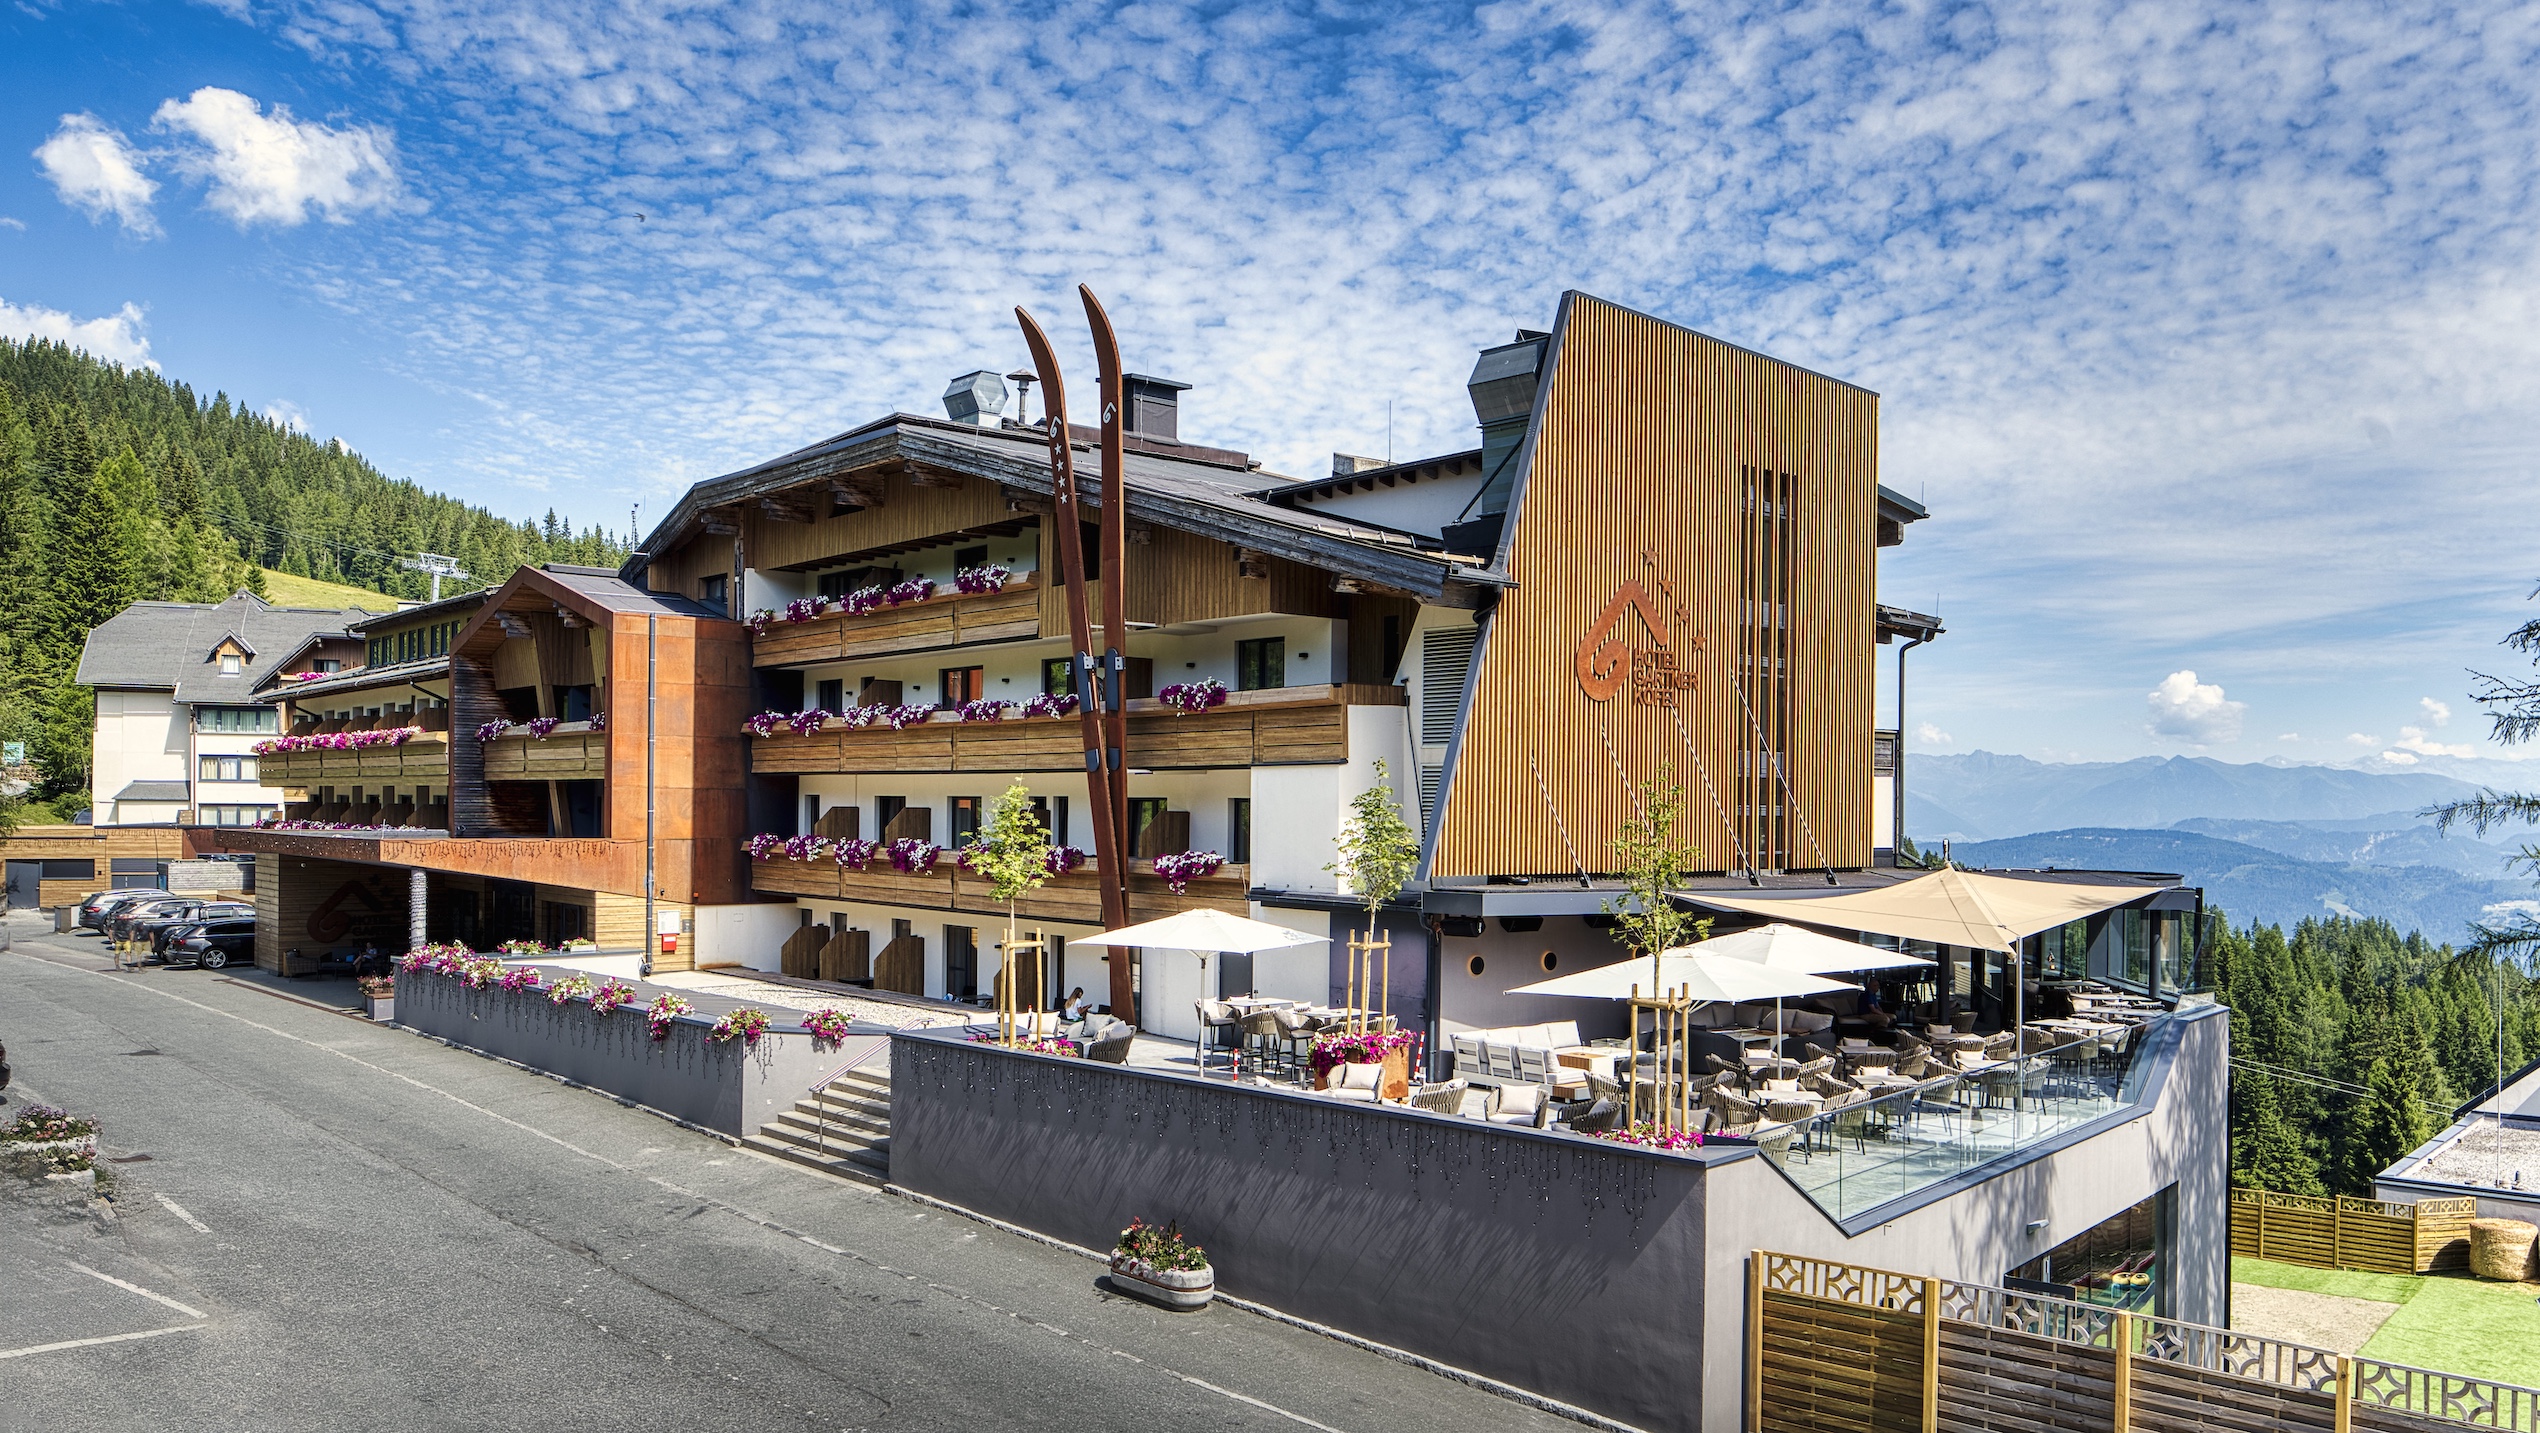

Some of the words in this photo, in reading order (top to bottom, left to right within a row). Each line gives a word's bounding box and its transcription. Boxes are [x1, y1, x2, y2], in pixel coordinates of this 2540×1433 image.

[1634, 648, 1680, 670] HOTEL
[1634, 667, 1699, 690] GARTNER
[1634, 687, 1680, 707] KOFEL
